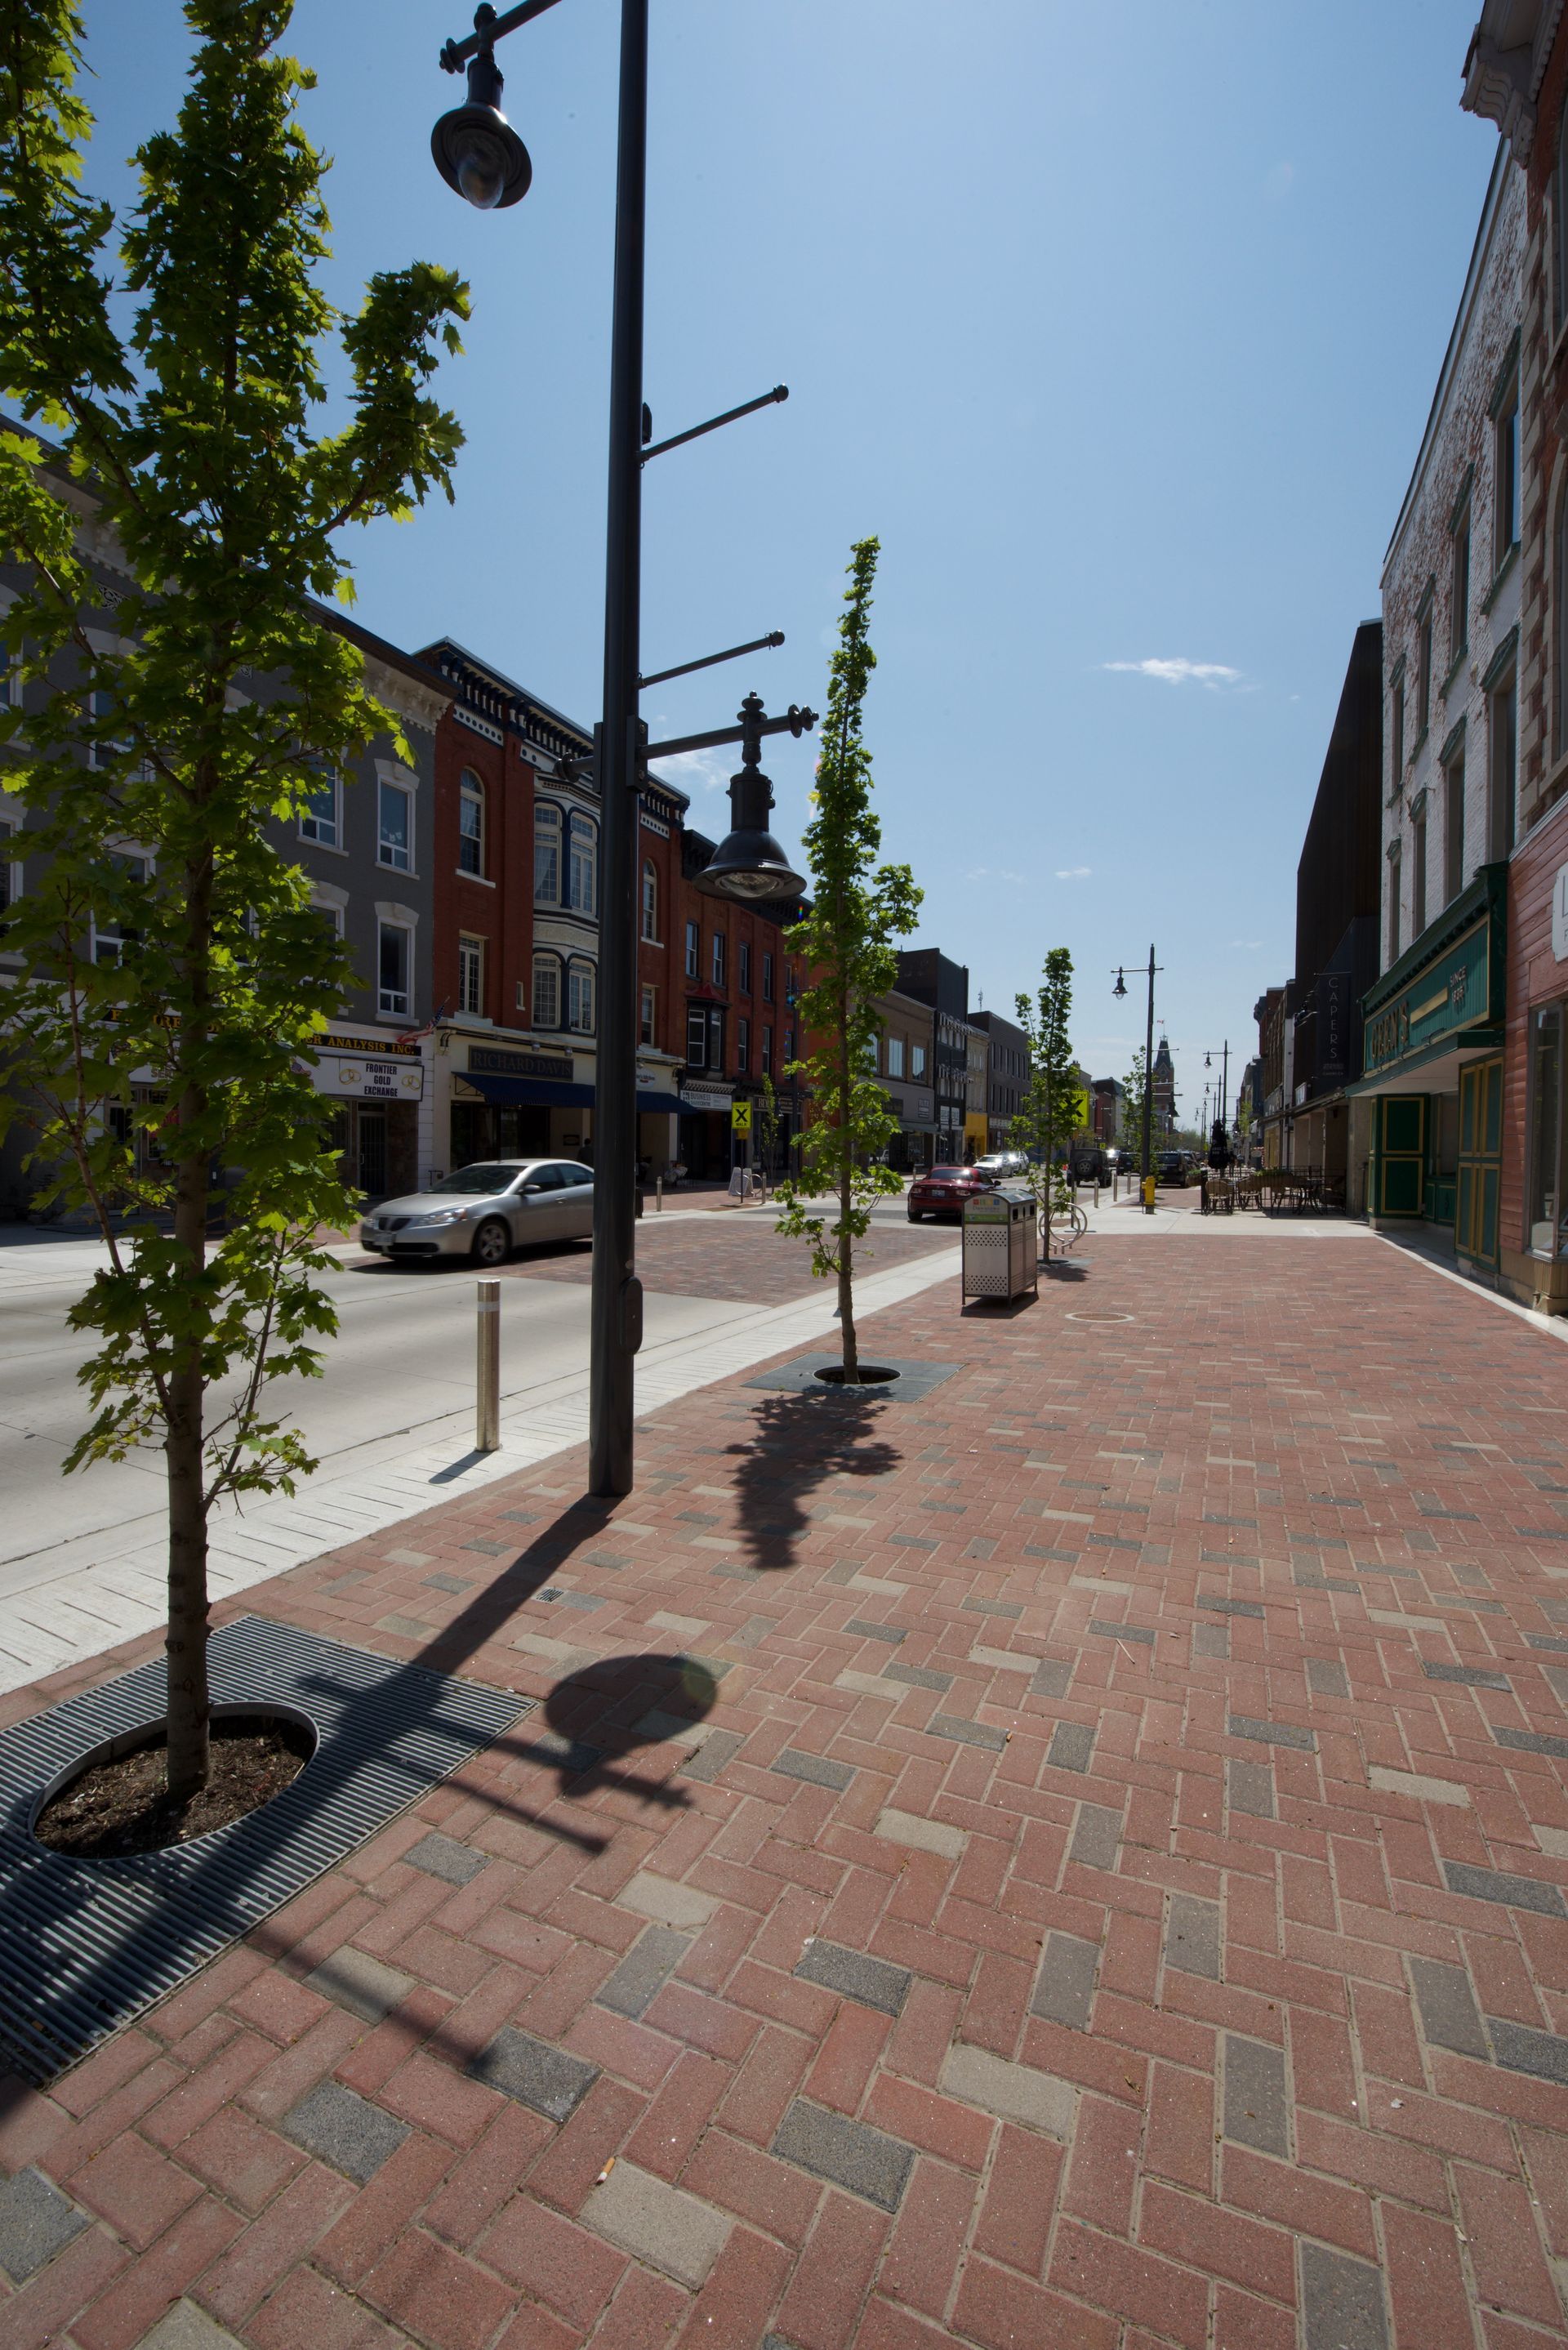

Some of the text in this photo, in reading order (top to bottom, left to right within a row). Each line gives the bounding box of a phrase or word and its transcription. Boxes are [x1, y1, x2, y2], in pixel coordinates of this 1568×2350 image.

[1328, 977, 1339, 1059] CAPERS
[327, 1037, 386, 1053] ANALYSIS
[391, 1044, 415, 1055] INC.
[365, 1063, 398, 1075] FRONTIER
[473, 1051, 572, 1077] RICHARD DAVIS
[373, 1075, 391, 1086] GOLD
[363, 1086, 398, 1097] EXCHANGE
[690, 1092, 711, 1101] BUSINESS
